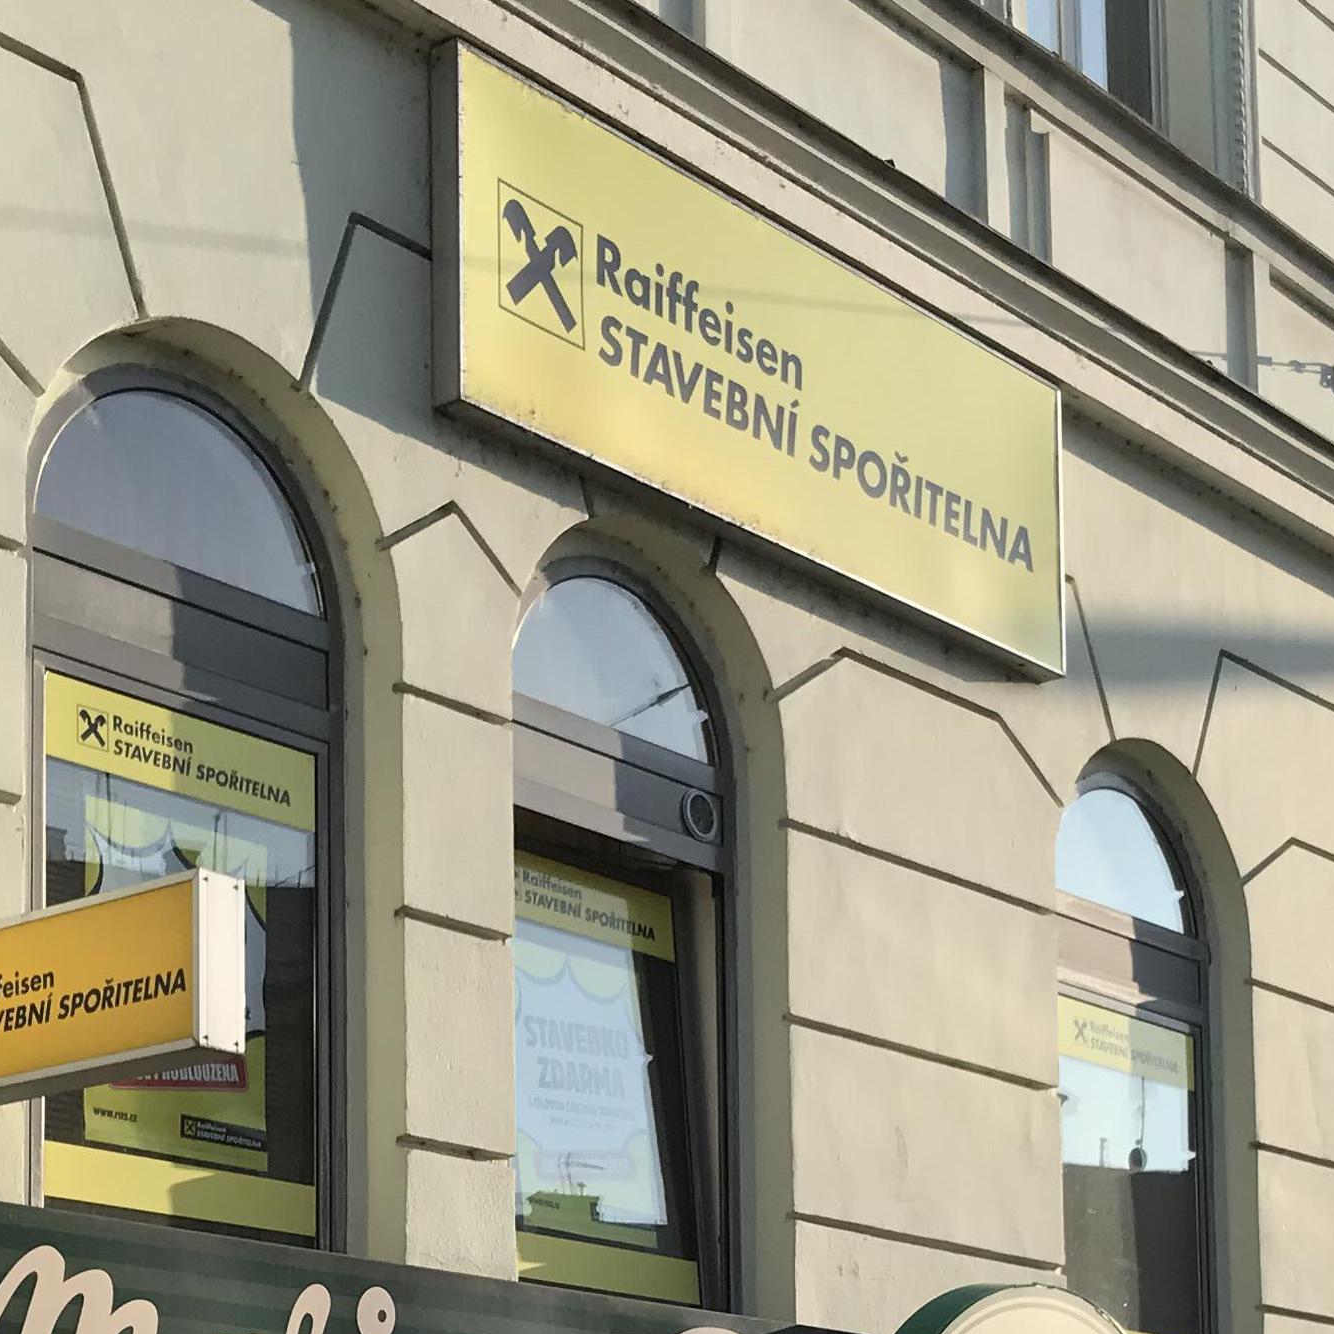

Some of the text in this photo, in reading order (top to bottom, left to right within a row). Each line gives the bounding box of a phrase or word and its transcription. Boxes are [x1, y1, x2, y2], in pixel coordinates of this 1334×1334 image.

[596, 233, 804, 391] Raiffeisen
[598, 315, 1035, 574] STAVEBNÍ SPOŘITELNA
[112, 714, 194, 756] Raiffeisen
[113, 738, 292, 808] STAVEBNÍ SPOŘITELNA
[523, 868, 583, 901] Raiffeisen
[524, 889, 656, 942] STAVEBNÍ SPOŘITELNA
[58, 967, 187, 1022] SPOŘITELNA
[537, 1056, 626, 1100] ZDARMA
